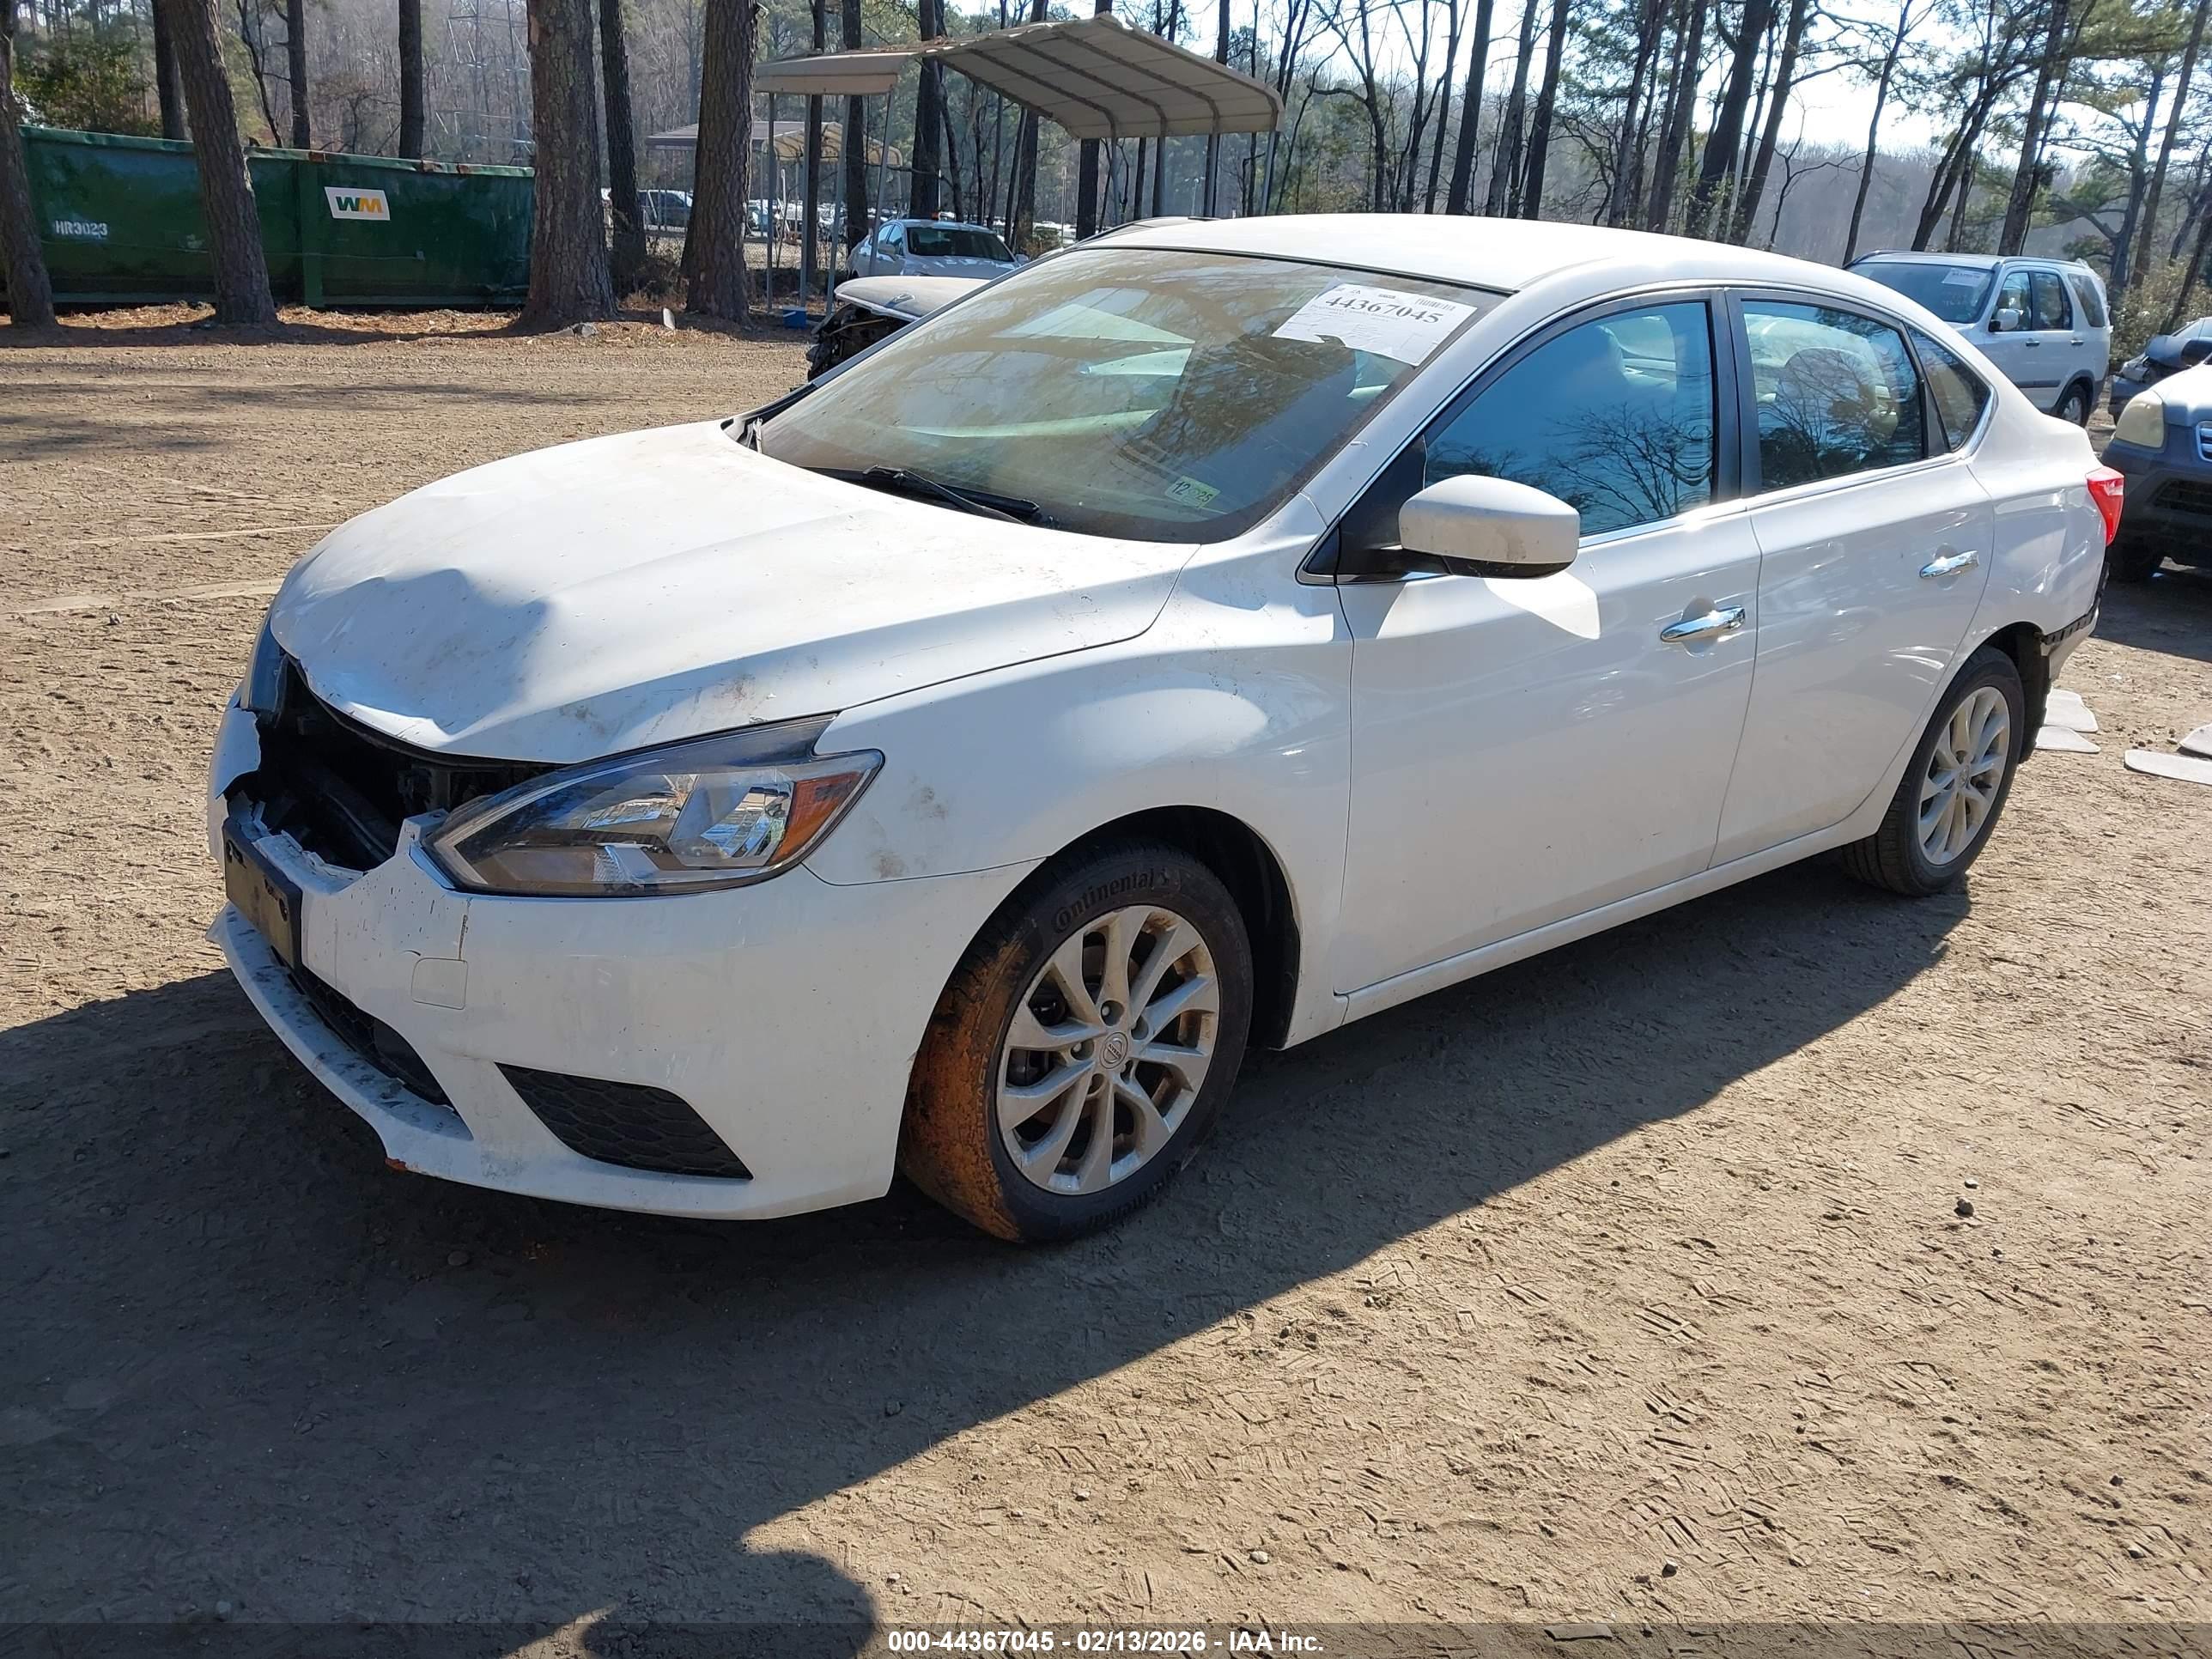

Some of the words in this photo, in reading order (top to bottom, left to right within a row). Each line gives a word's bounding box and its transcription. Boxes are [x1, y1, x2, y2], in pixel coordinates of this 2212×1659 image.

[335, 196, 384, 214] WM
[55, 220, 108, 236] HR3023
[1325, 296, 1443, 324] 44367045
[1171, 481, 1191, 495] 12
[1195, 490, 1213, 502] 25
[1053, 867, 1155, 934] Continental
